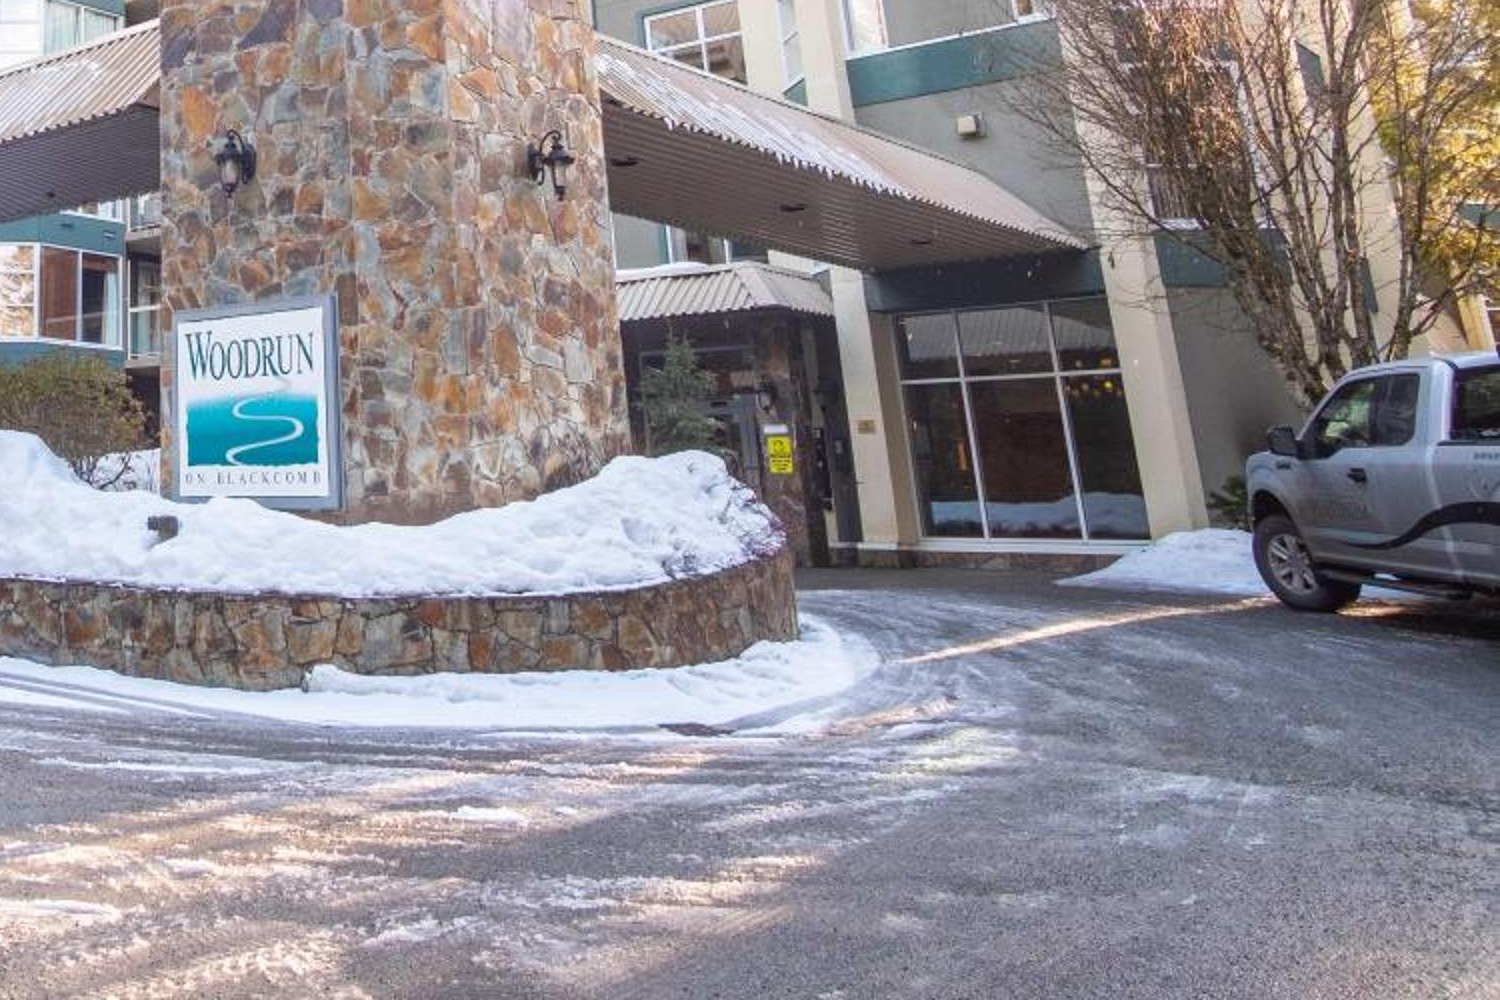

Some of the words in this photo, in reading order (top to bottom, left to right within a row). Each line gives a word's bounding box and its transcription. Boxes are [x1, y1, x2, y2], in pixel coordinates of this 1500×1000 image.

[185, 331, 314, 381] WOODRUN
[185, 472, 205, 485] ON
[217, 470, 322, 485] BLACKCOMB
